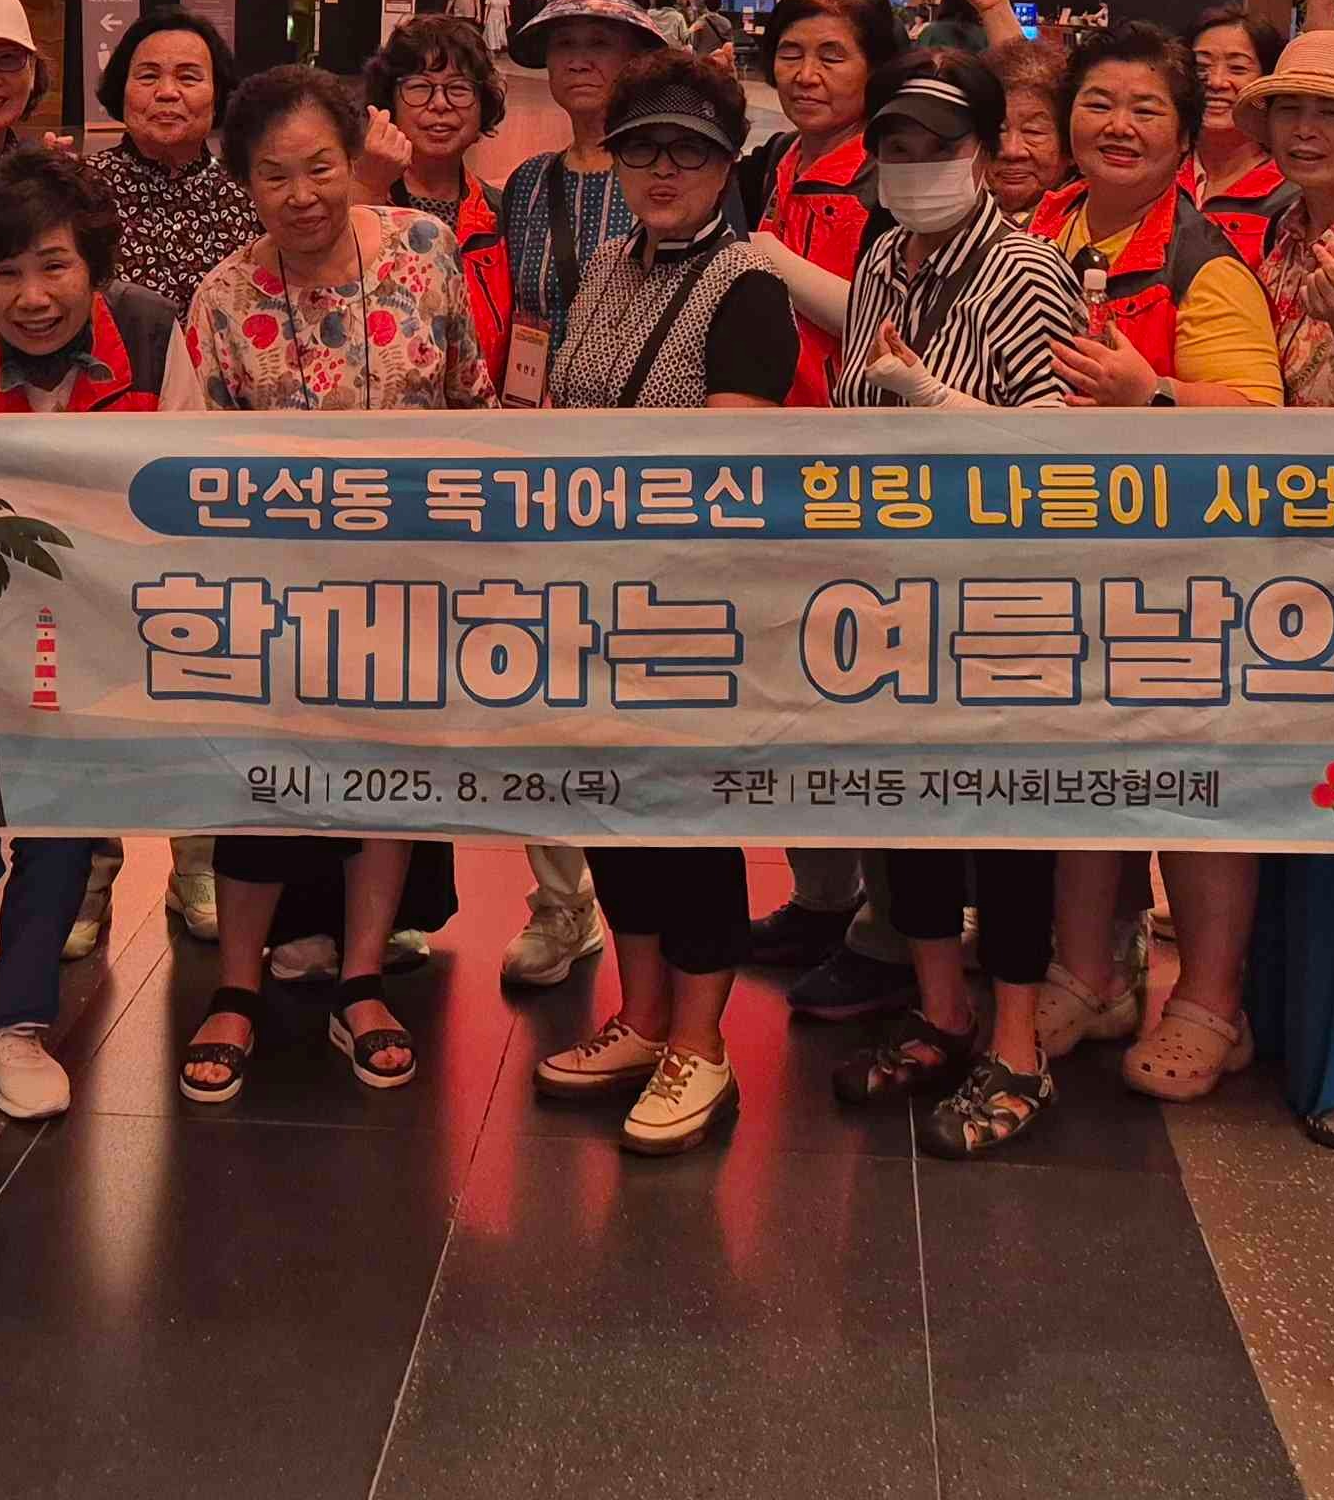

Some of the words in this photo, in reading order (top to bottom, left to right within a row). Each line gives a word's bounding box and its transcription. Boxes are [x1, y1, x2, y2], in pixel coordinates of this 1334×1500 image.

[189, 466, 392, 532] 만석동
[425, 463, 766, 532] 독거어르신
[800, 460, 934, 531] 힐링
[967, 463, 1169, 530] 나들이
[131, 572, 744, 709] 함께하는
[247, 765, 311, 804] 일시
[342, 769, 443, 802] 2025.
[456, 771, 489, 803] 8.
[502, 769, 621, 805] 28.(목)
[711, 769, 779, 806] 주관
[807, 769, 907, 806] 만석동
[919, 768, 1221, 809] 지역사회보장협의체
